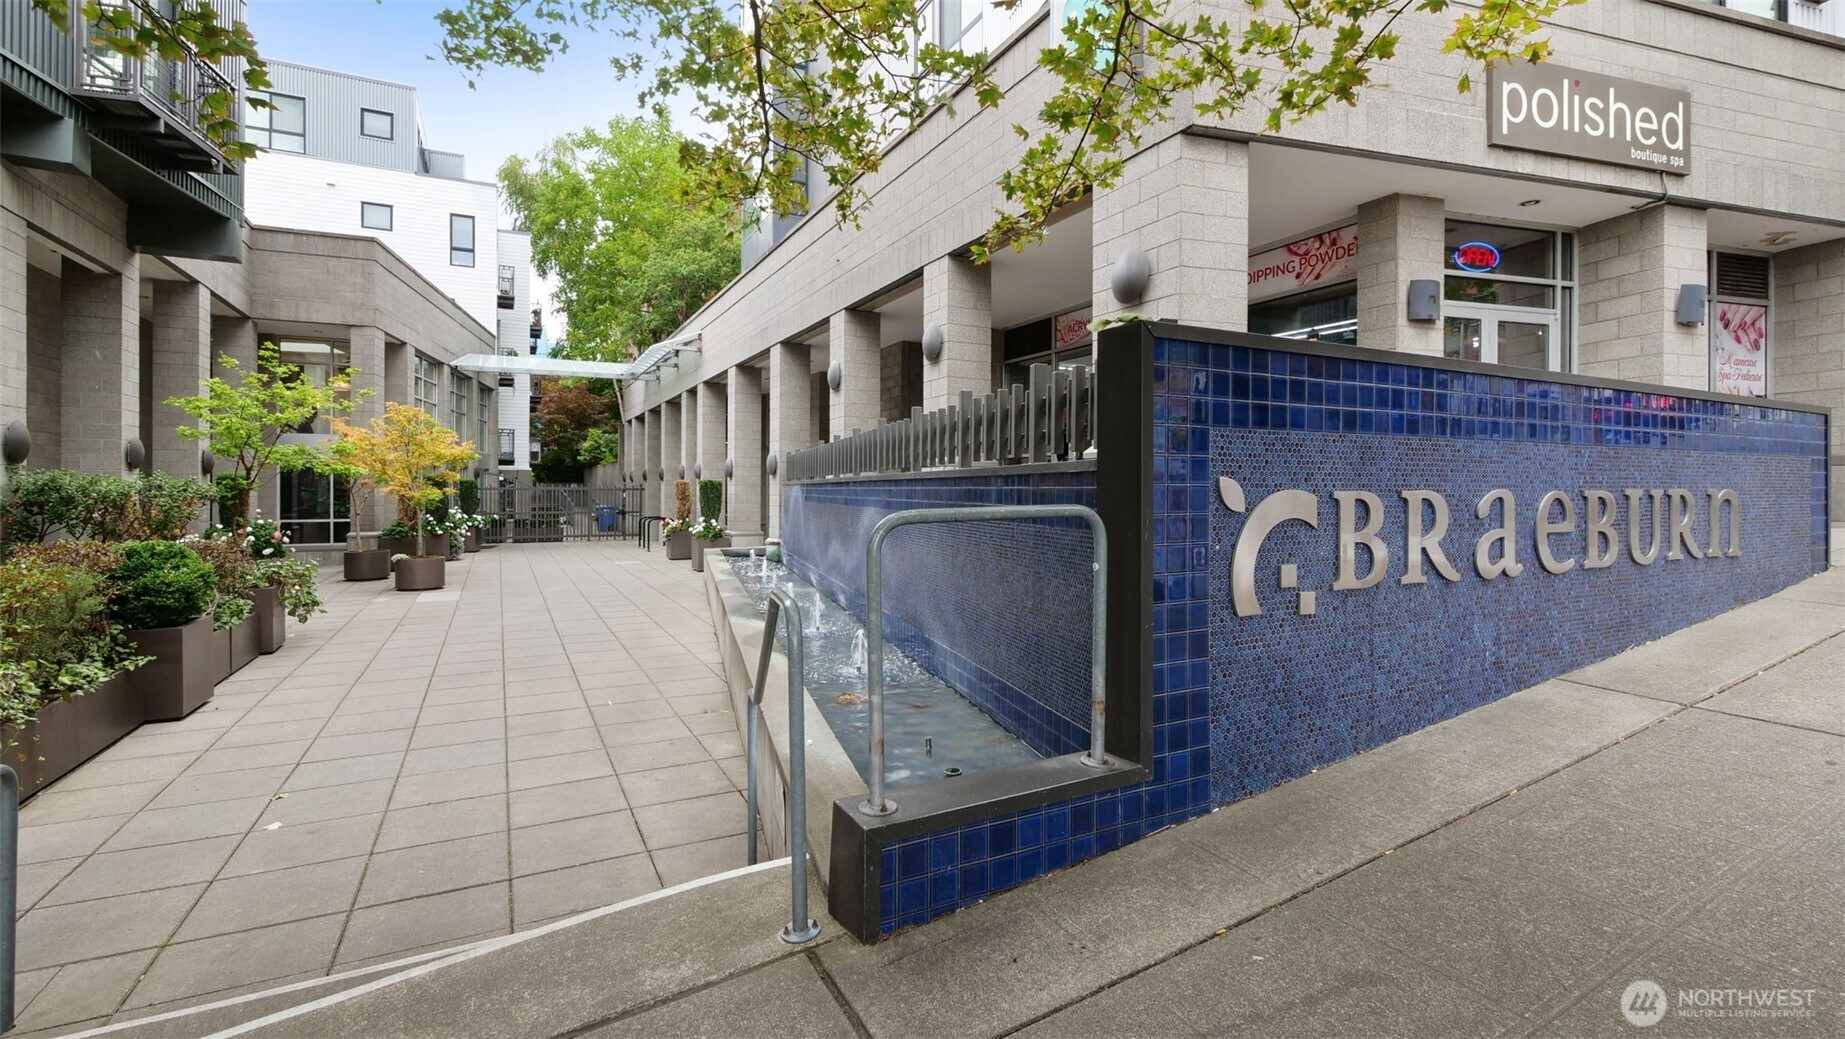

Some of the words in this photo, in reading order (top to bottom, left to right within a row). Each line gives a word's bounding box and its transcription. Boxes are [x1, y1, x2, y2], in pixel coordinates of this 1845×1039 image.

[1502, 78, 1684, 150] polished
[1630, 147, 1668, 164] boutique
[1669, 154, 1684, 167] spa
[1299, 242, 1358, 271] POWDE
[1458, 247, 1496, 267] OPEN
